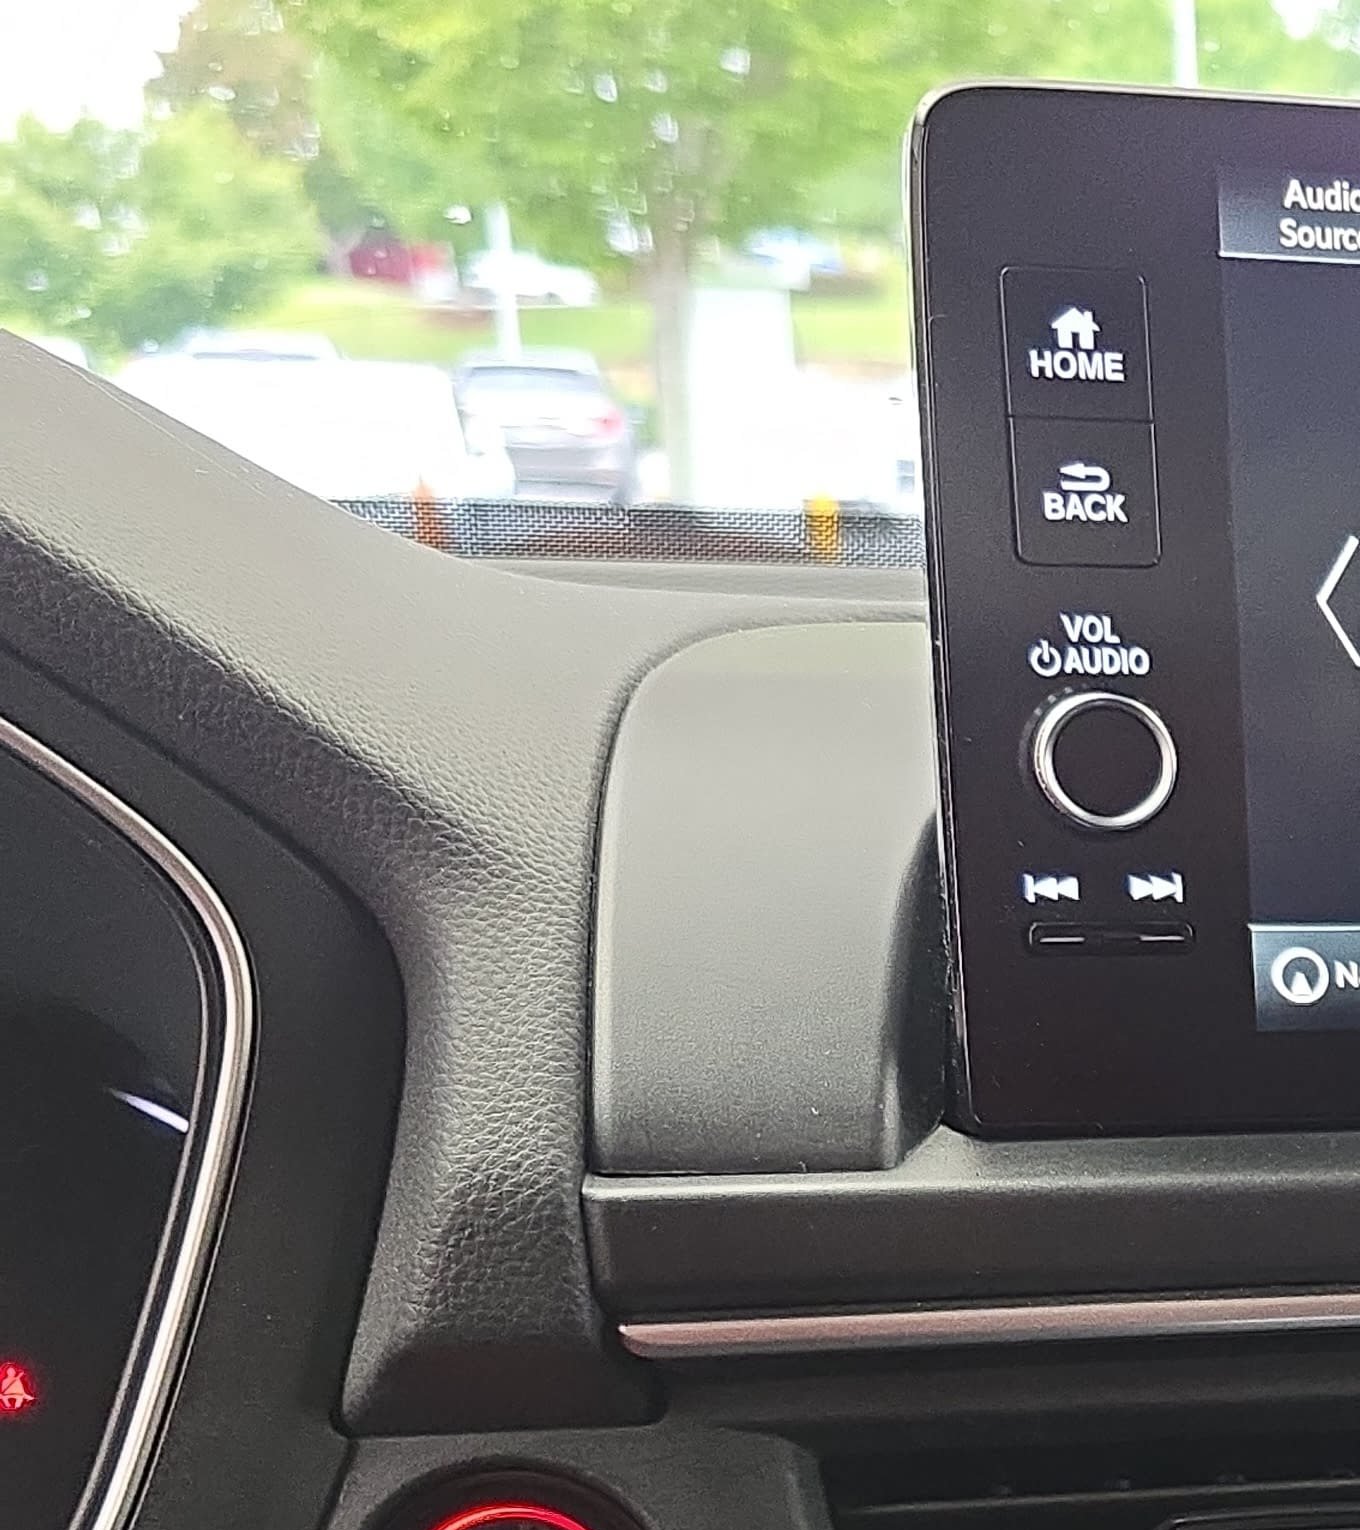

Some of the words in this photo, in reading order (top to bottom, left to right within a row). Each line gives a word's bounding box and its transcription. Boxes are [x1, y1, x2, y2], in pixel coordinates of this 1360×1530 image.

[1029, 350, 1124, 381] HOME
[1043, 492, 1128, 524] BACK
[1060, 612, 1120, 643] VOL
[1065, 647, 1150, 675] AUDIO
